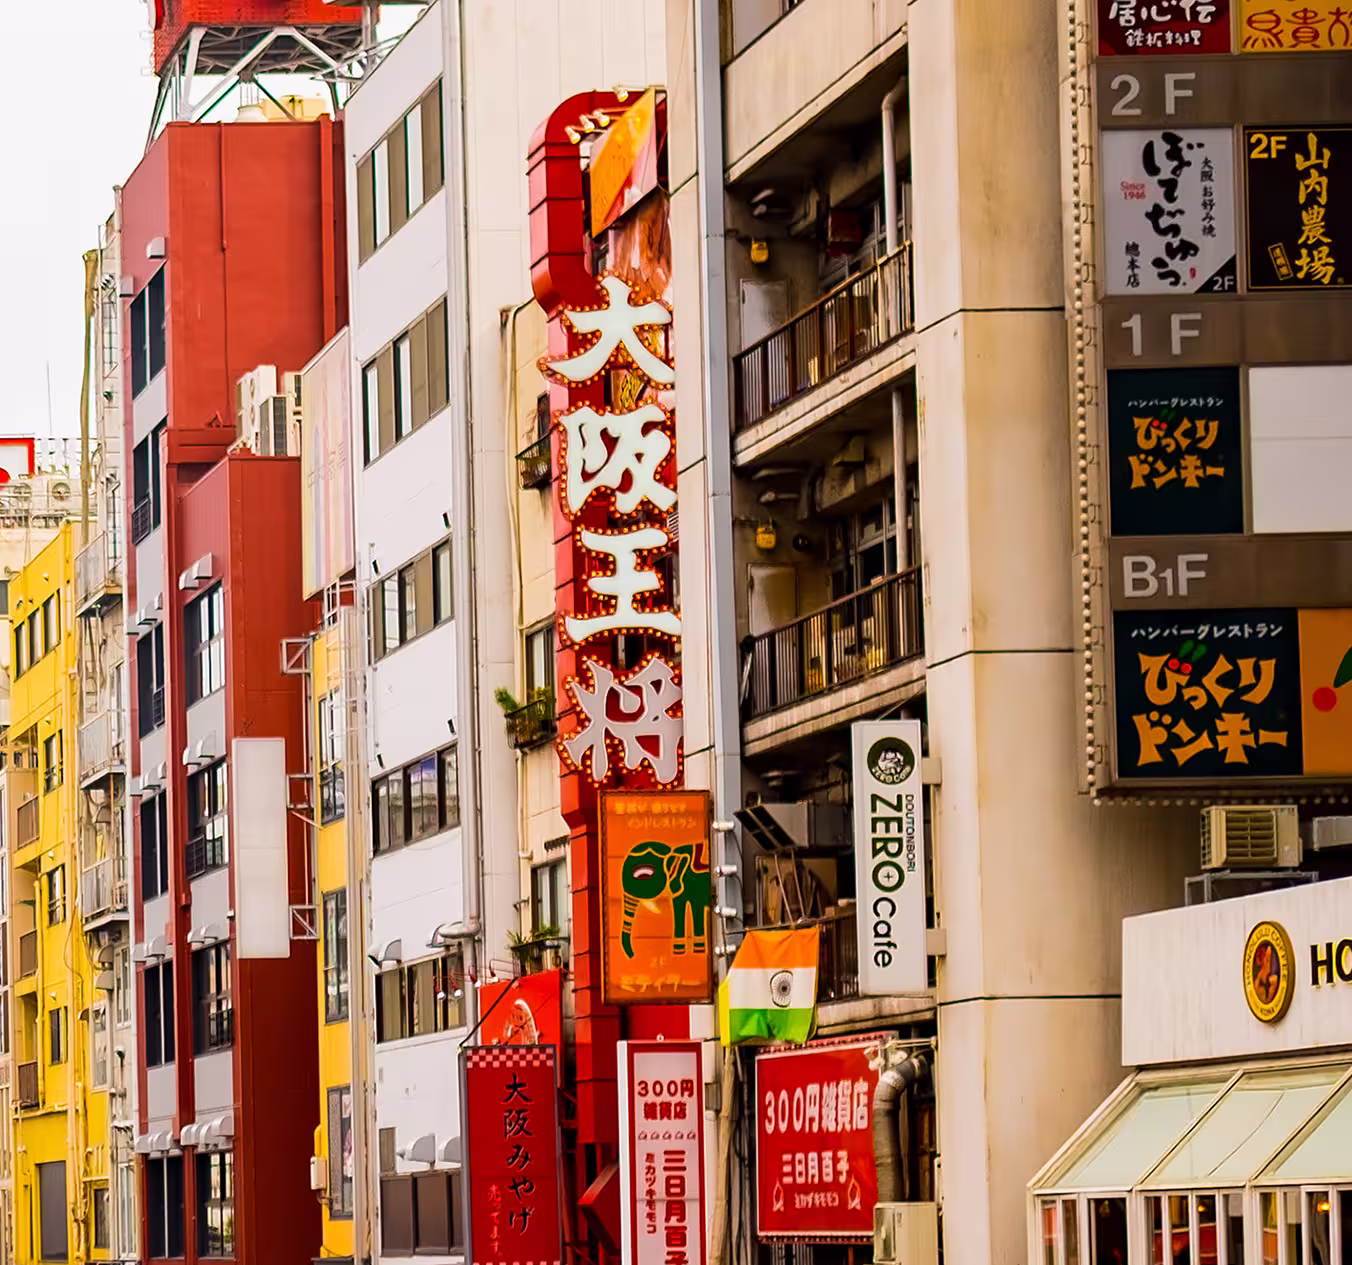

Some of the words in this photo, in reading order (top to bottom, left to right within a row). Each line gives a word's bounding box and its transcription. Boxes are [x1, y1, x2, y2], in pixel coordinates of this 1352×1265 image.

[1125, 28, 1201, 47] 鉄板料理
[1250, 132, 1287, 159] 2F
[1120, 181, 1146, 191] Since
[1123, 191, 1146, 200] 1946
[1295, 132, 1336, 285] 山内農場
[1213, 276, 1234, 291] 2F
[1128, 397, 1224, 409] ハンバーグレストラン
[1132, 416, 1220, 454] びっくり
[1128, 454, 1225, 490] ドンキー
[545, 277, 684, 784] 大阪王将
[1123, 554, 1209, 598] B1F
[1131, 623, 1283, 640] ハンバーグレストラン
[1138, 653, 1277, 710] びっくり
[1132, 710, 1288, 767] ドンキー
[871, 793, 905, 893] ZERO
[502, 1073, 536, 1236] 大阪みやげ
[782, 1150, 849, 1184] 三日月百子
